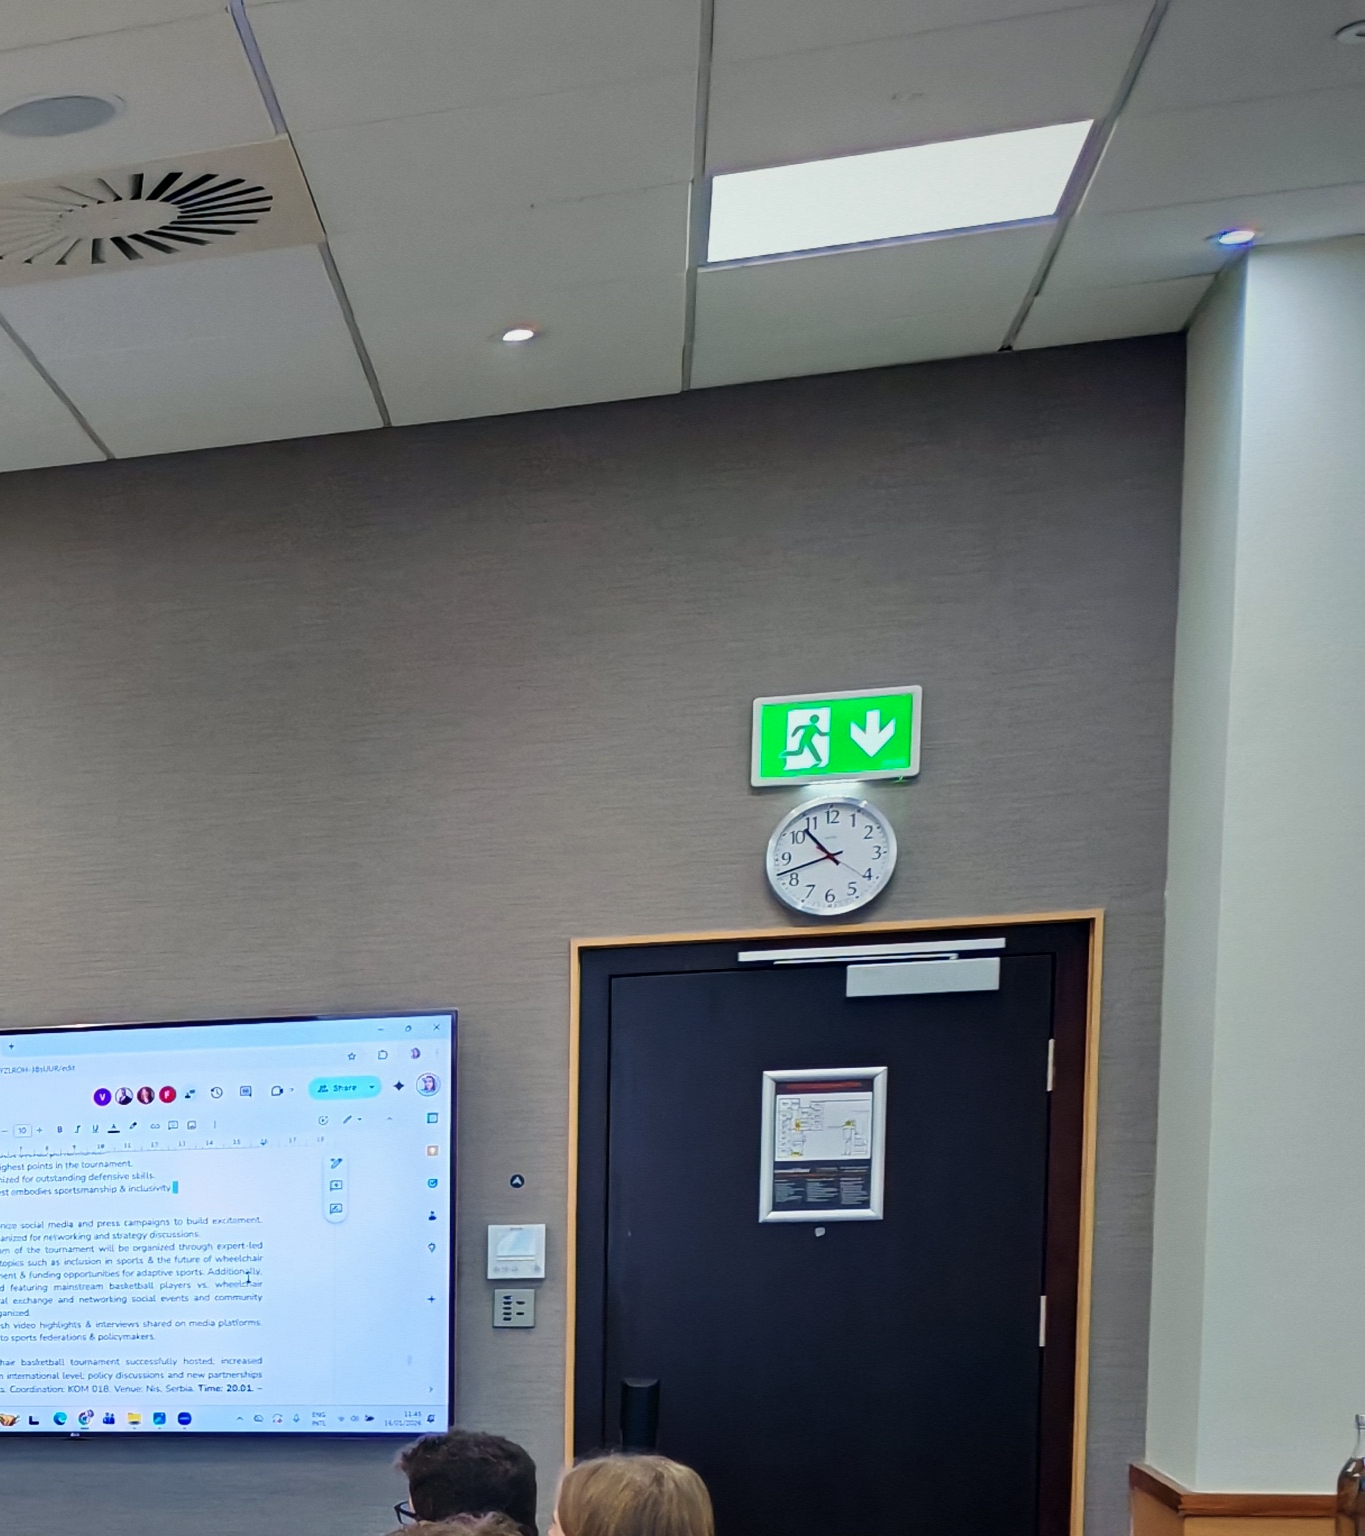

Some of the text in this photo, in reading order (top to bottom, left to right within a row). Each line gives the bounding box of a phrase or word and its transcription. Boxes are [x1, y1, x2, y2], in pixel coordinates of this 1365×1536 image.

[806, 816, 817, 830] 11
[825, 810, 840, 824] 12
[850, 813, 856, 827] 1
[790, 830, 805, 844] 10
[863, 825, 873, 839] 2
[781, 852, 791, 866] 9
[871, 846, 881, 860] 3
[789, 872, 799, 886] 8
[862, 868, 873, 880] 4
[804, 884, 815, 899] 7
[825, 889, 835, 902] 6
[847, 882, 857, 896] 5
[27, 1161, 53, 1173] points
[35, 1173, 86, 1185] outstanding
[88, 1172, 129, 1182] defensive
[54, 1185, 117, 1197] sportsmanship
[20, 1217, 208, 1230] social media and press campaigns build
[93, 1232, 110, 1241] and
[112, 1231, 147, 1242] strategy
[45, 1245, 94, 1254] tournament
[132, 1243, 175, 1255] organized
[178, 1243, 213, 1254] through
[27, 1258, 47, 1267] such
[116, 1256, 143, 1267] sports
[174, 1255, 199, 1264] future
[215, 1254, 262, 1264] wheelchair
[28, 1270, 61, 1281] funding
[63, 1270, 119, 1281] opportunities
[136, 1269, 172, 1280] adaptive
[10, 1283, 47, 1294] featuring
[53, 1282, 103, 1291] mainstream
[109, 1281, 153, 1290] basketball
[159, 1281, 191, 1292] players
[58, 1296, 74, 1304] and
[78, 1295, 127, 1306] networking
[131, 1295, 155, 1303] social
[160, 1294, 188, 1303] events
[193, 1294, 210, 1302] and
[214, 1293, 262, 1304] community
[13, 1321, 36, 1330] video
[143, 1320, 172, 1328] shared
[188, 1319, 215, 1328] media
[11, 1333, 37, 1344] sports
[39, 1333, 86, 1342] federations
[20, 1358, 64, 1366] basketball
[70, 1357, 119, 1366] tournament
[87, 1371, 113, 1381] policy
[115, 1371, 163, 1379] discussions
[168, 1371, 184, 1379] and
[207, 1370, 262, 1381] partnerships
[67, 1385, 89, 1393] KOM
